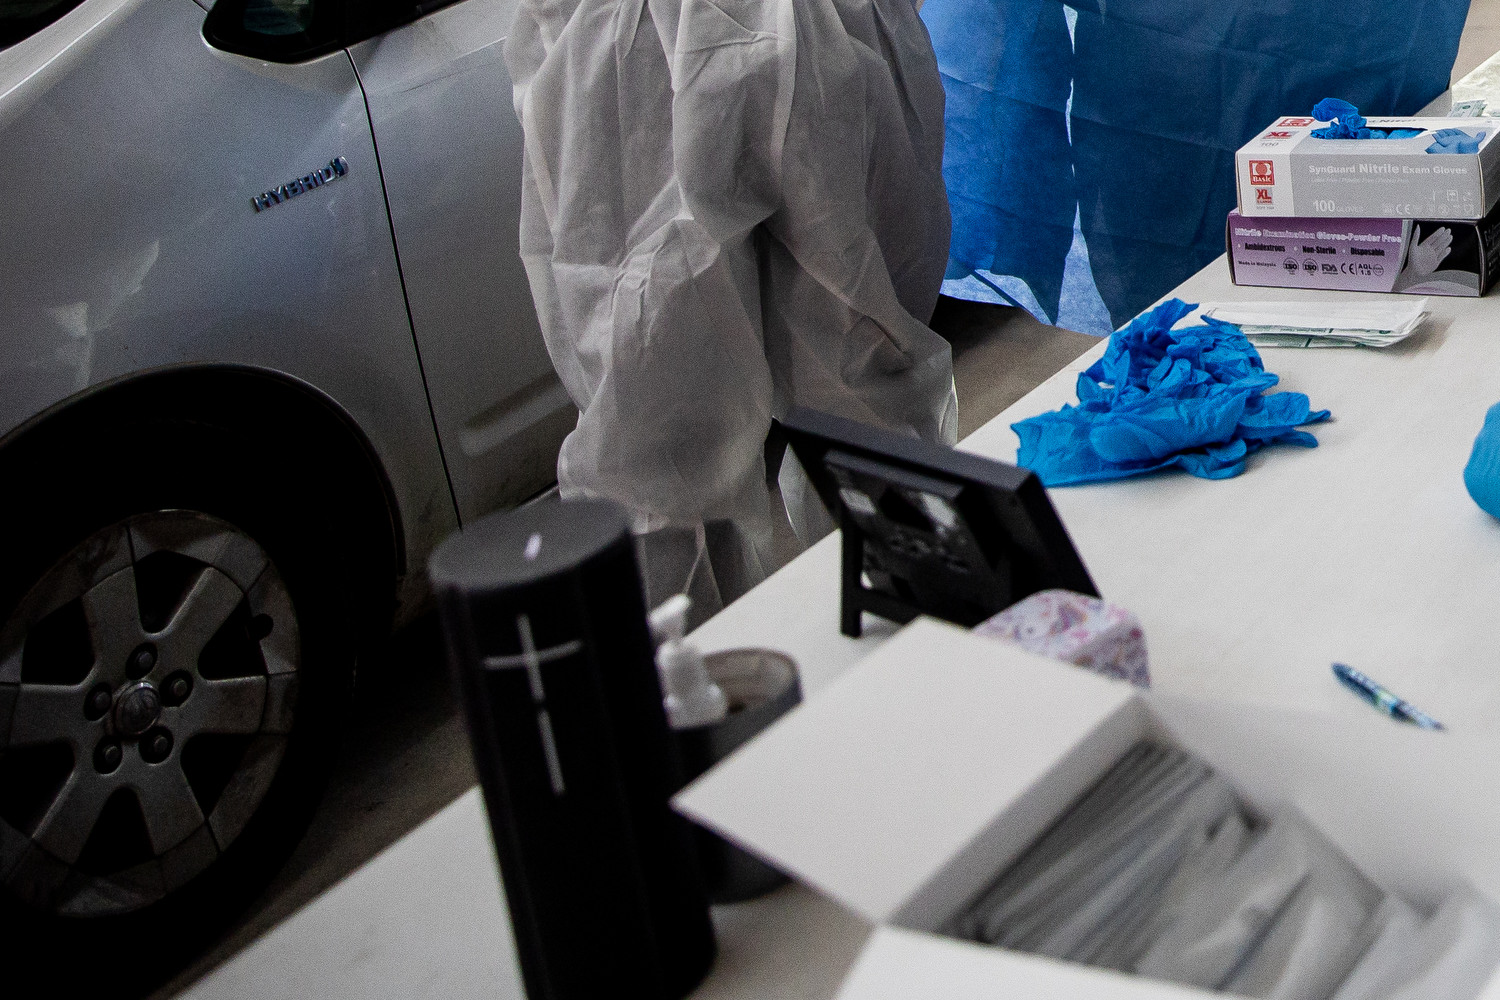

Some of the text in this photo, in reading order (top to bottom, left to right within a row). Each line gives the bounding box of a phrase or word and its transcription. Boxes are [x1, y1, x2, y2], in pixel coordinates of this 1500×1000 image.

[1308, 163, 1468, 175] SynGuard Nitrile Exam Gloves
[253, 164, 336, 213] HYBRID
[1256, 188, 1272, 199] XL
[1312, 200, 1336, 212] 100
[1302, 246, 1337, 255] Non-Sterile
[1350, 247, 1386, 257] Disposable
[1321, 263, 1338, 272] FDA
